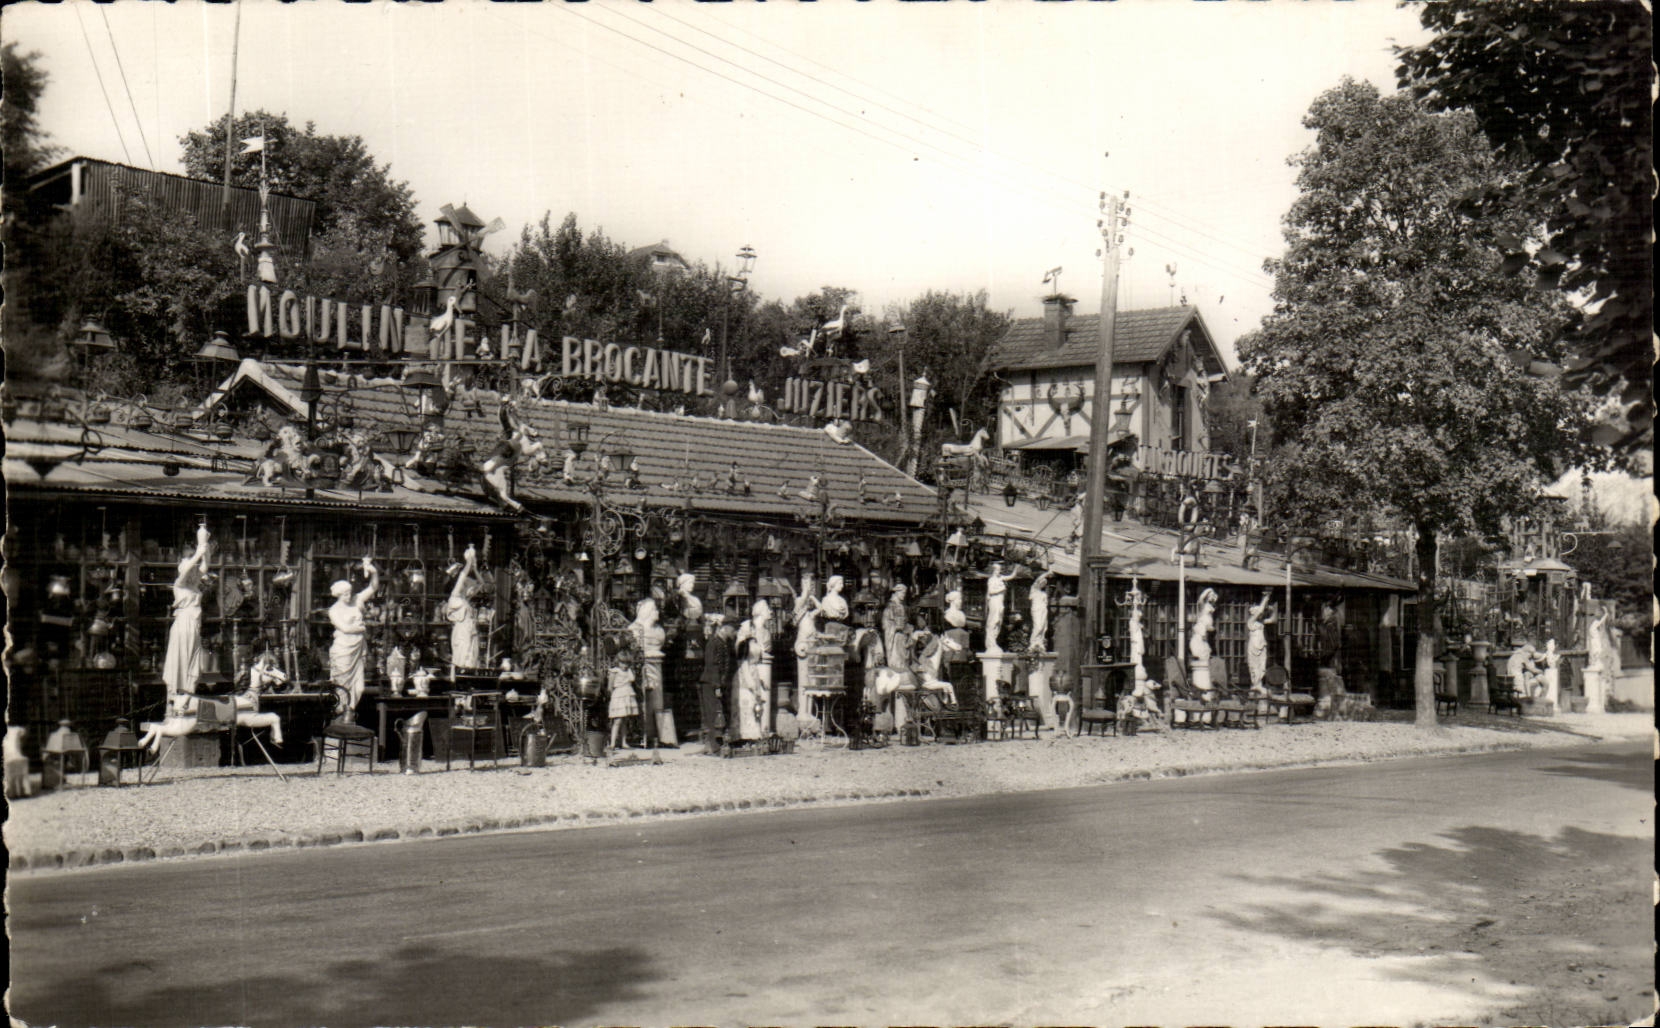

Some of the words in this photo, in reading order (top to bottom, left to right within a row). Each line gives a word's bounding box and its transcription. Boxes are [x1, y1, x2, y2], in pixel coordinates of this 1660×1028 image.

[246, 284, 404, 353] MOULIN
[561, 336, 715, 397] BROCANTE
[776, 376, 885, 422] JUZIERS
